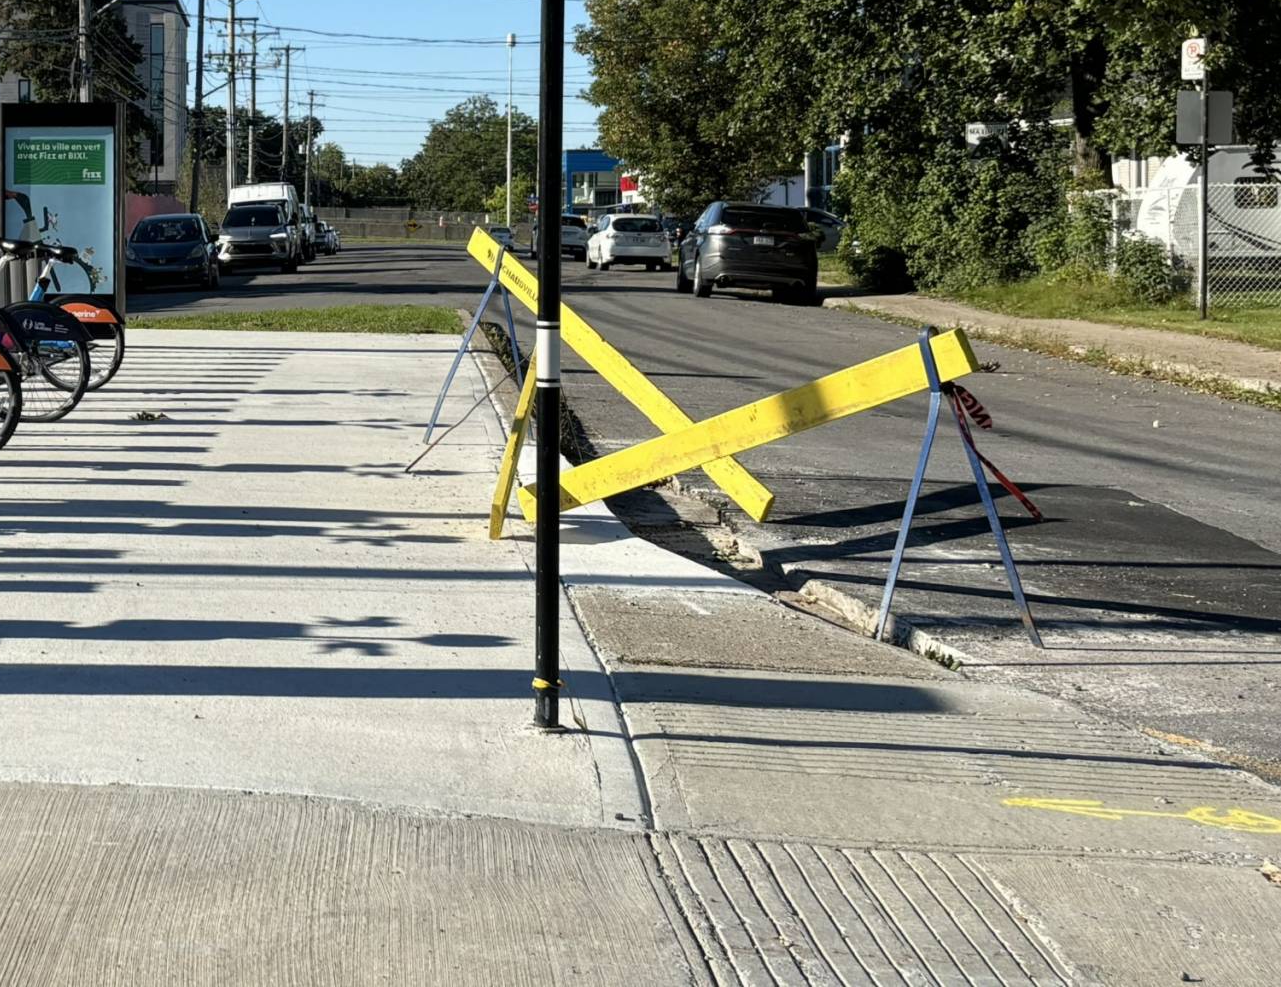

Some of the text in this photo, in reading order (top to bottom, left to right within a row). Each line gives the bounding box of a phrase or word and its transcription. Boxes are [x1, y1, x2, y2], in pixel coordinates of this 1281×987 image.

[17, 142, 40, 151] Vivez
[42, 142, 50, 151] la
[52, 142, 70, 151] ville
[83, 143, 101, 151] vert
[39, 152, 57, 160] Fizz
[58, 152, 67, 160] et
[68, 152, 88, 160] BIXI.
[501, 264, 538, 301] CHAUDVILL
